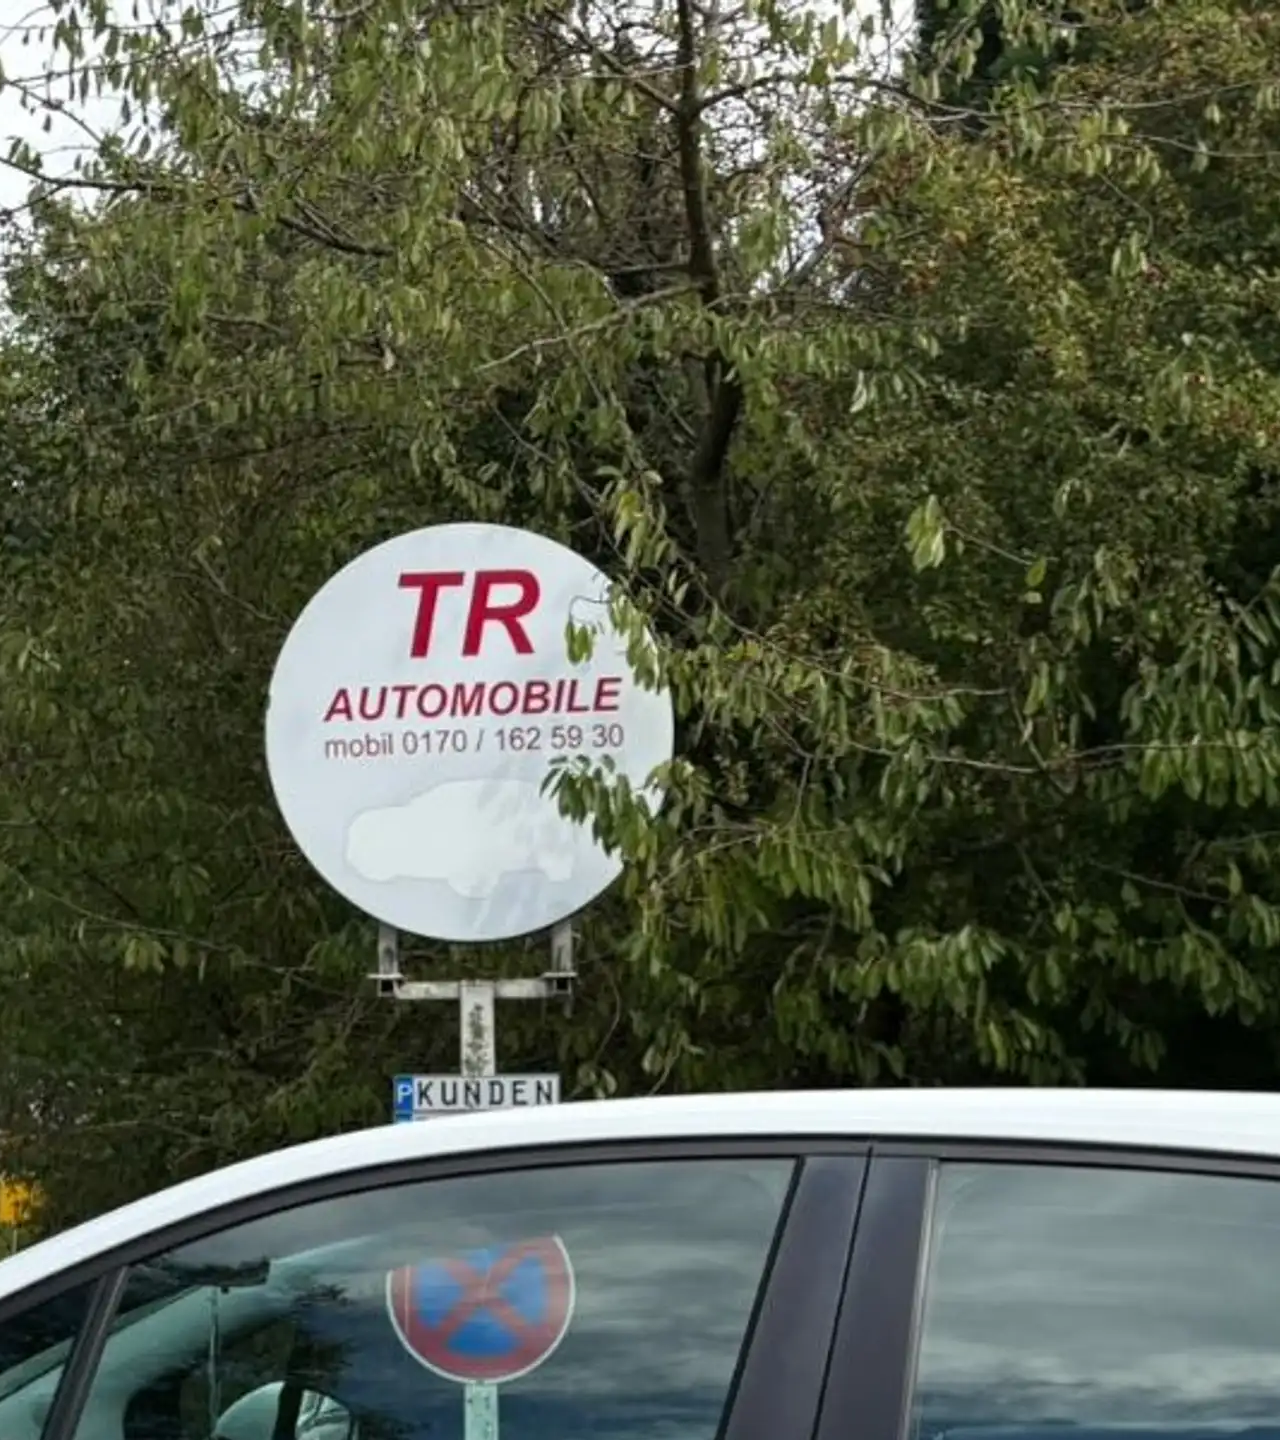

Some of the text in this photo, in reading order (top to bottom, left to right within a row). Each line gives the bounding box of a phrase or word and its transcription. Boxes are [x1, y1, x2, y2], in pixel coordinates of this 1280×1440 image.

[398, 569, 540, 658] TR
[323, 677, 623, 722] AUTOMOBILE
[324, 723, 625, 759] mobil 0170 / 162 59 30
[417, 1080, 553, 1106] KUNDEN
